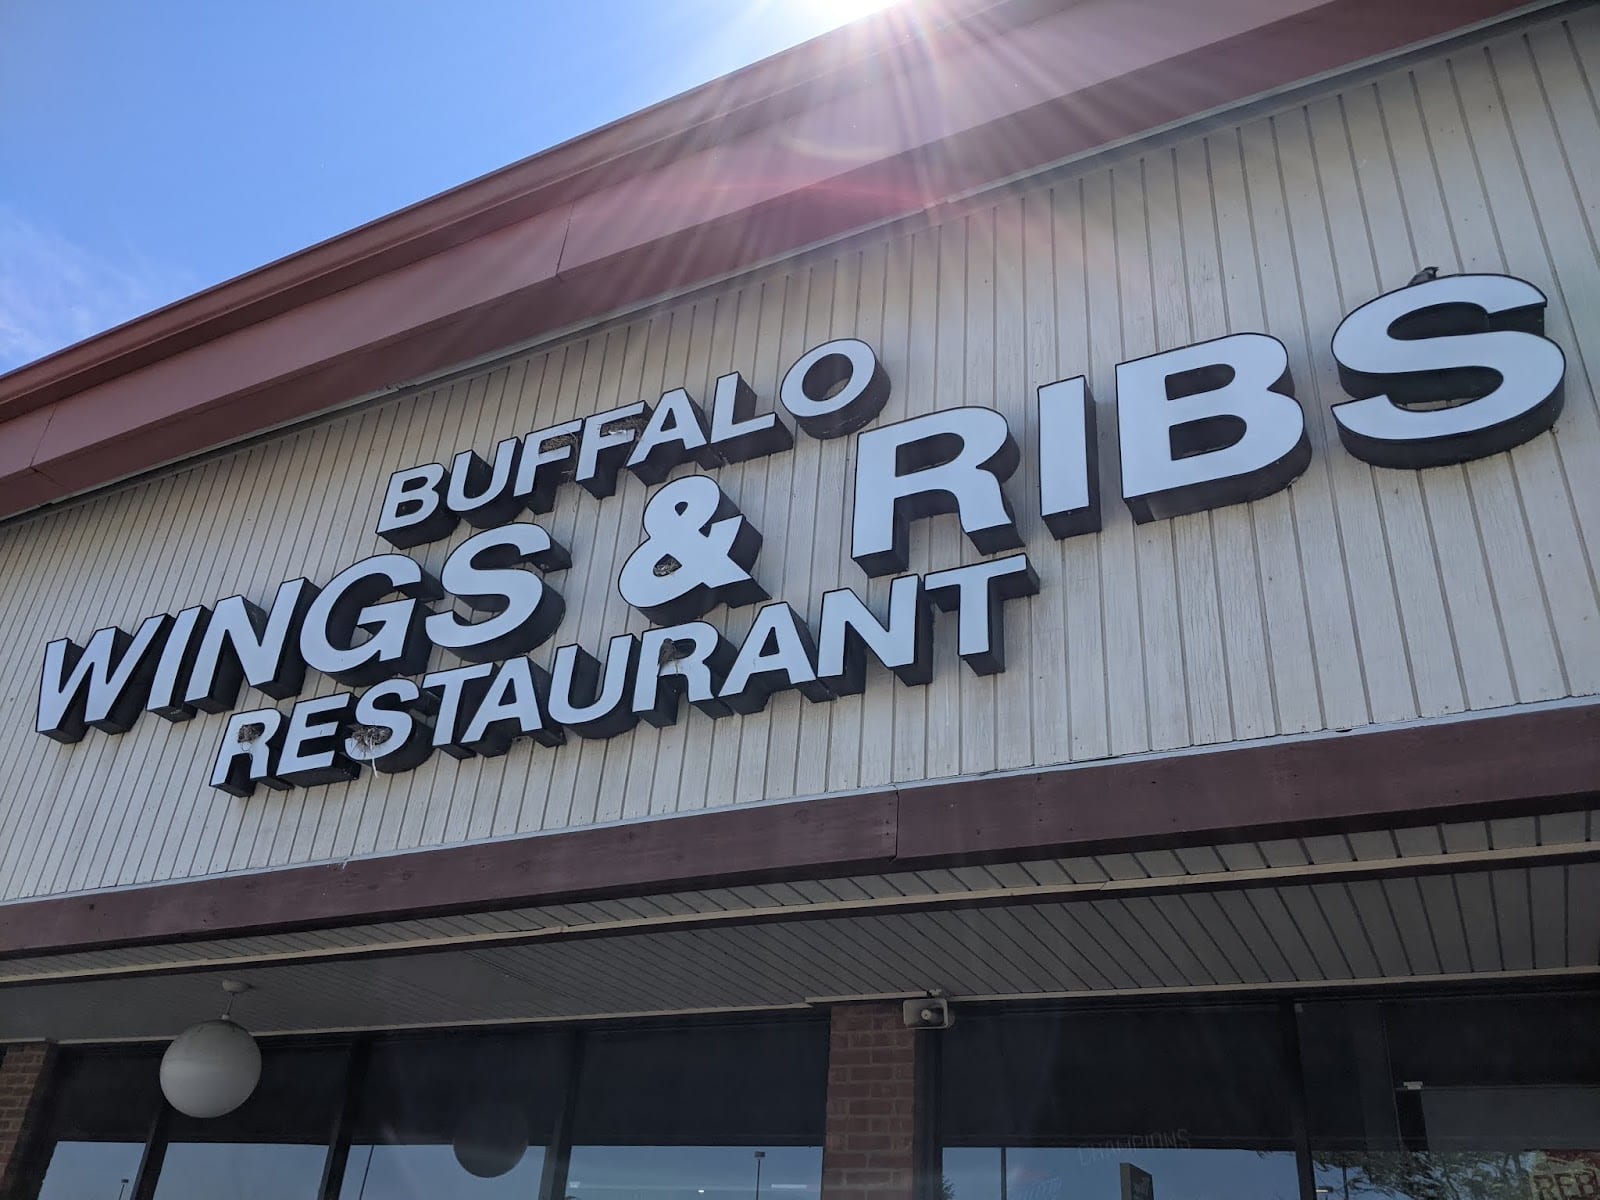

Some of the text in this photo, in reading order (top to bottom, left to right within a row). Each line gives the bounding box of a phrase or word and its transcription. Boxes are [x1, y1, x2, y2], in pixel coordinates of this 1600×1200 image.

[36, 273, 1567, 733] WINGS & RIBS
[377, 337, 878, 534] BUFFALO
[210, 553, 1027, 787] RESTAURANT
